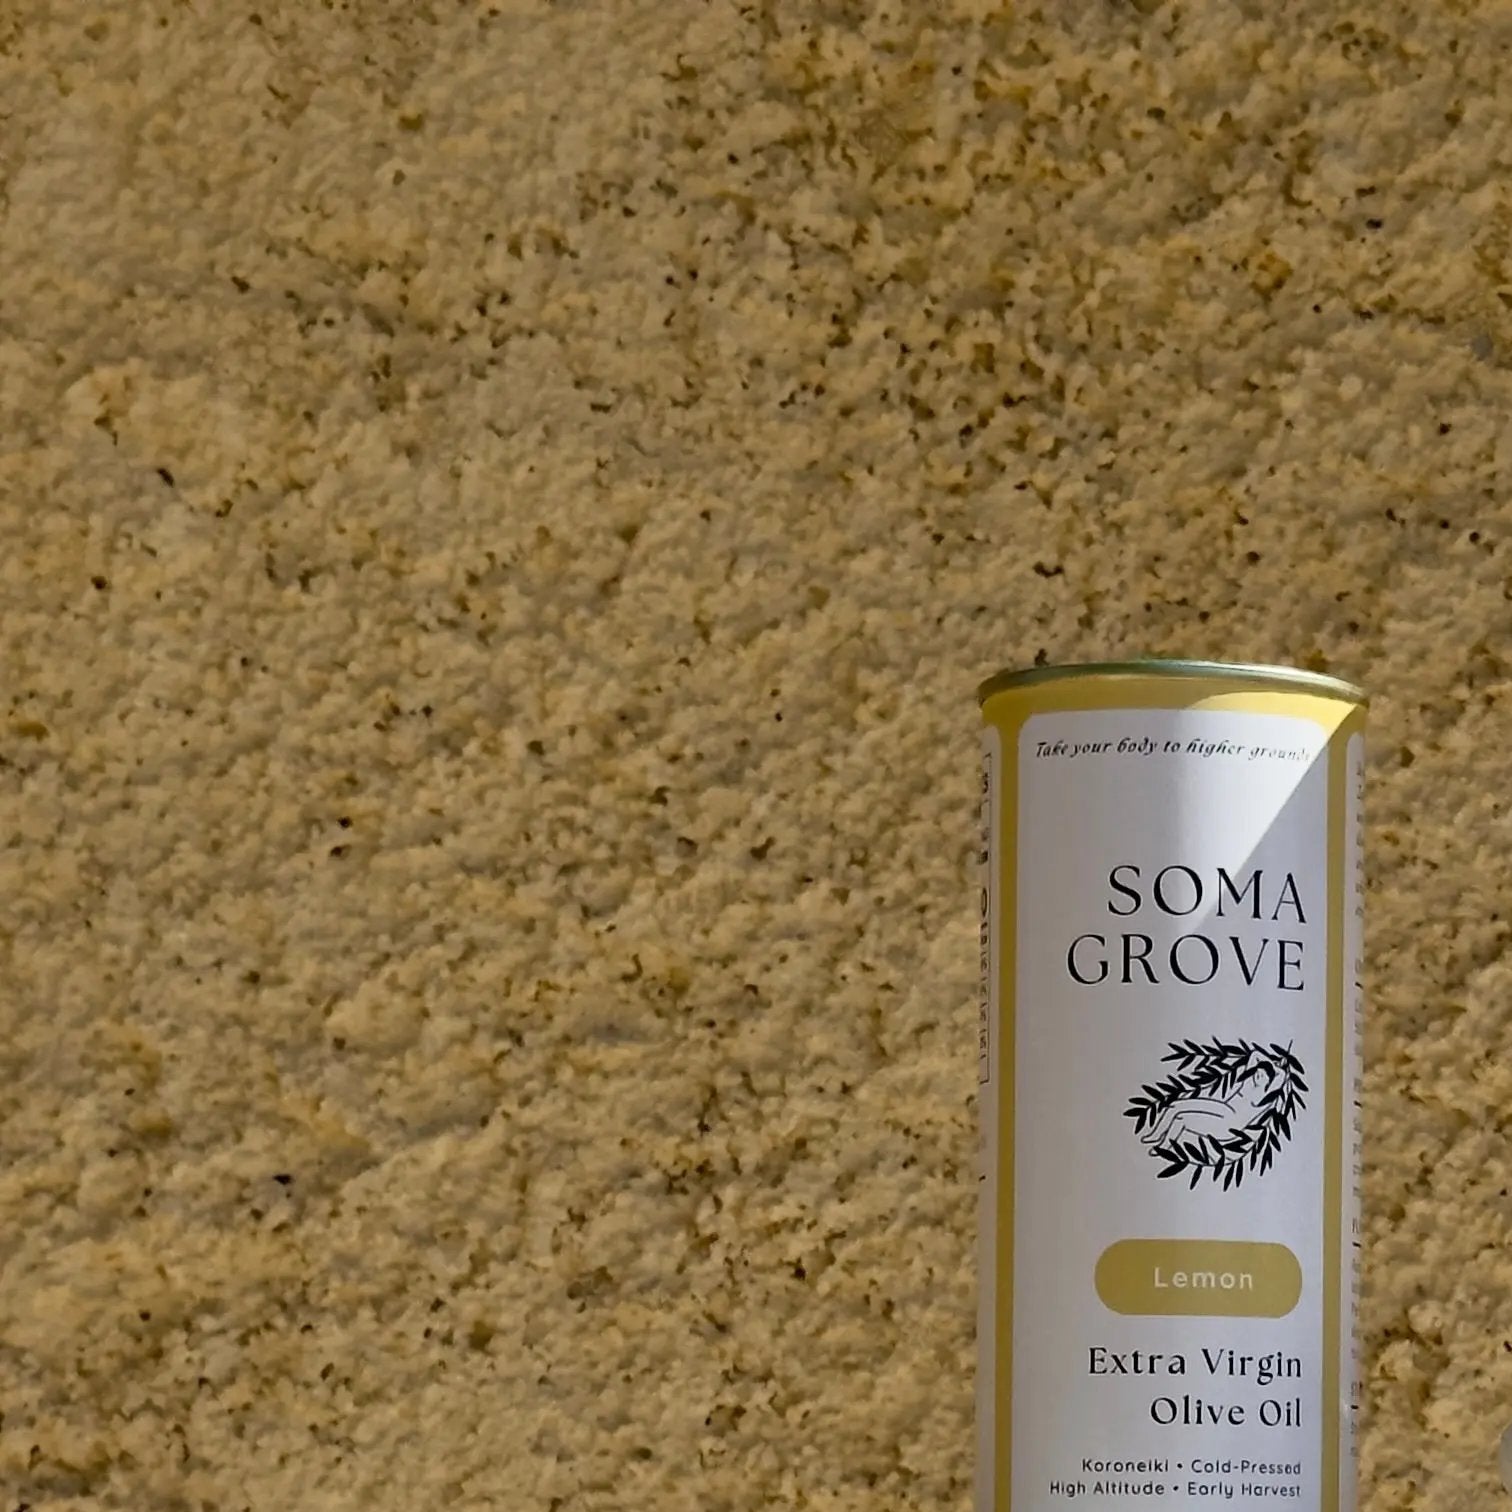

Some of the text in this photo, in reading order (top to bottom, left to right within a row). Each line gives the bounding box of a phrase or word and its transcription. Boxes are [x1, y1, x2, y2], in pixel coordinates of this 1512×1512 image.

[1036, 740, 1069, 758] Take
[1069, 740, 1113, 758] your
[1117, 737, 1157, 756] body
[1163, 740, 1181, 753] to
[1185, 738, 1245, 757] higher
[1108, 865, 1306, 923] SOMA
[1068, 934, 1304, 991] GROVE
[1155, 1267, 1253, 1291] Lemon
[1089, 1347, 1301, 1385] Extra Virgin
[1151, 1395, 1300, 1427] Olive Oil
[1082, 1458, 1301, 1475] Koroneiki Cold-Pressed
[1049, 1480, 1300, 1499] High Altitude Early Harvest
